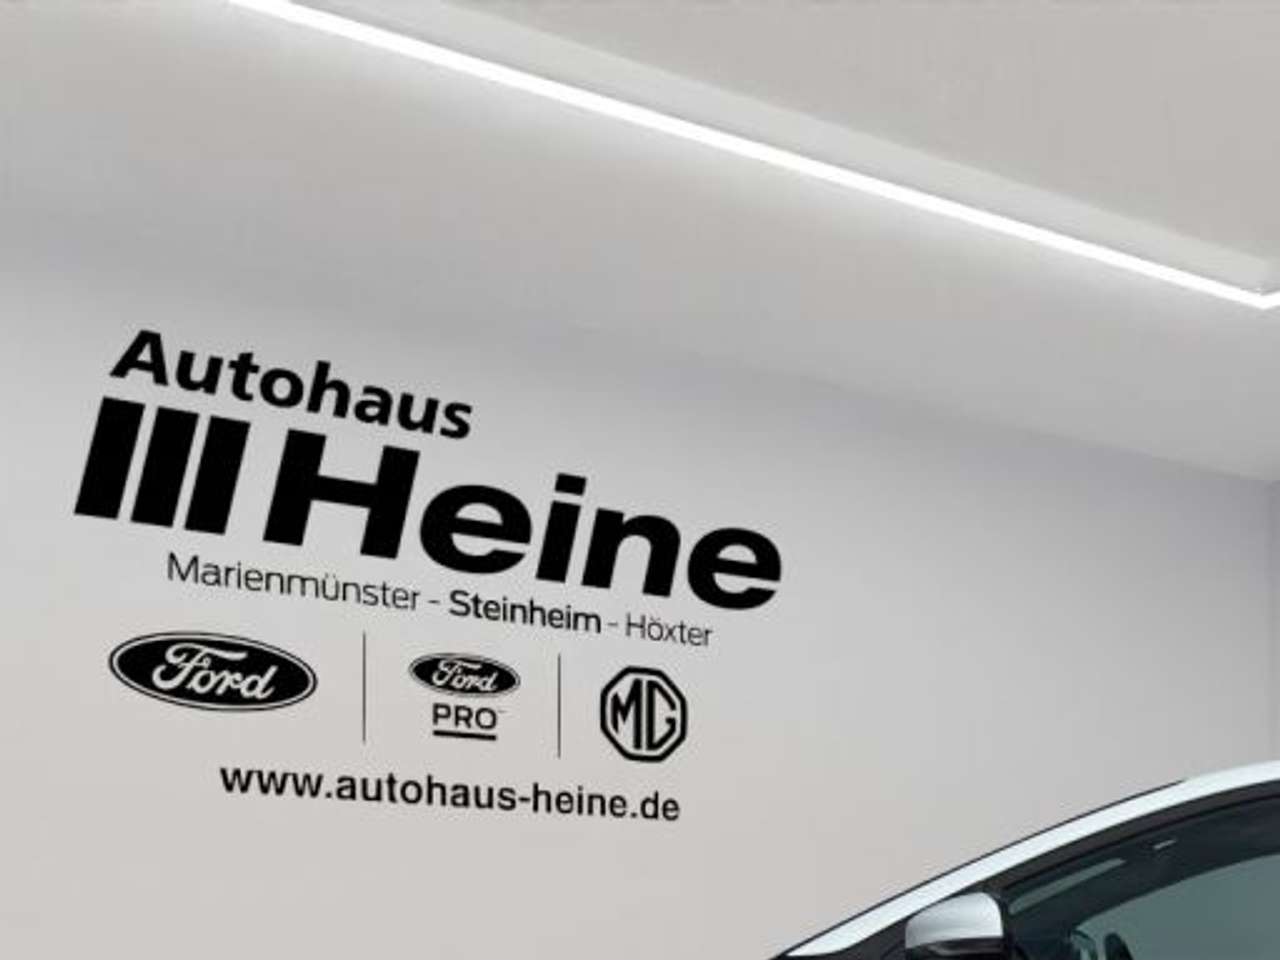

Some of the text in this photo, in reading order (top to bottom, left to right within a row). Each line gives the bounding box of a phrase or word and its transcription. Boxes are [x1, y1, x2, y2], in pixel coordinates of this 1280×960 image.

[109, 329, 473, 440] Autohaus
[262, 428, 782, 611] Heine
[167, 551, 420, 610] Marienmünster
[449, 589, 602, 634] Steinheim
[625, 614, 713, 647] Höxter
[152, 642, 278, 699] Ford
[432, 660, 498, 691] Ford
[432, 702, 498, 730] PRO
[610, 677, 677, 751] MG
[219, 767, 680, 822] www.autohaus-heine.de
